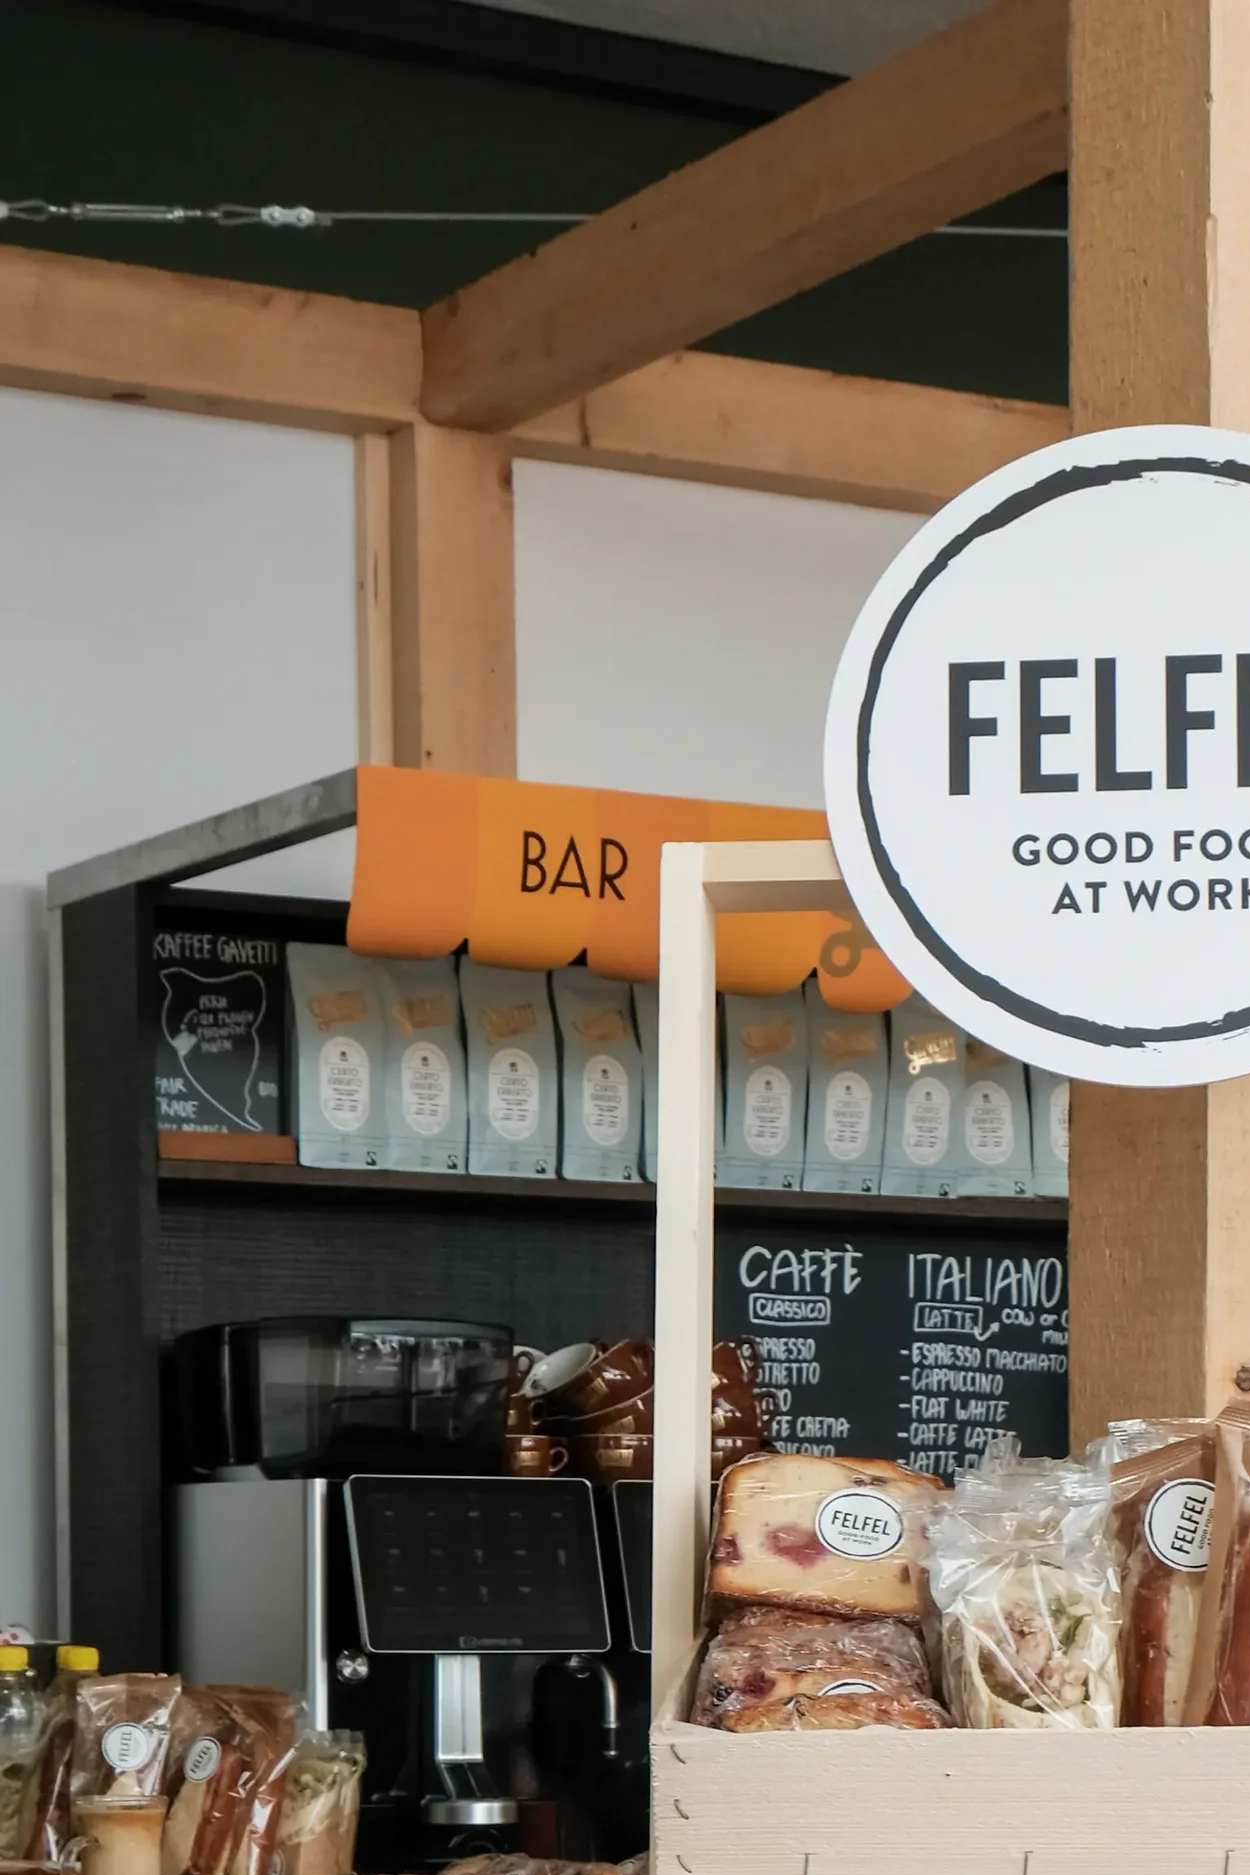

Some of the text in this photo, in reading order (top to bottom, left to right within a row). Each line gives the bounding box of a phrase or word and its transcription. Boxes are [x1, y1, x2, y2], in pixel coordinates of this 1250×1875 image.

[1012, 830, 1154, 867] GOOD
[520, 830, 629, 901] BAR
[1051, 880, 1108, 915] AT
[153, 933, 213, 960] KAFFEE
[739, 1243, 1063, 1308] CAFFÈ ITALIANO
[755, 1297, 826, 1320] CLASSICO
[924, 1307, 975, 1330] LATTE
[911, 1341, 1067, 1374] ESPRESSO MACCHIATO
[911, 1367, 1004, 1396] CAPPUCCINO
[911, 1395, 1010, 1422] FLAT WHITE
[796, 1415, 851, 1439] CREMA
[909, 1421, 959, 1446] CAFFE
[831, 1509, 891, 1536] FELFEL
[1170, 1495, 1208, 1555] FELFEL
